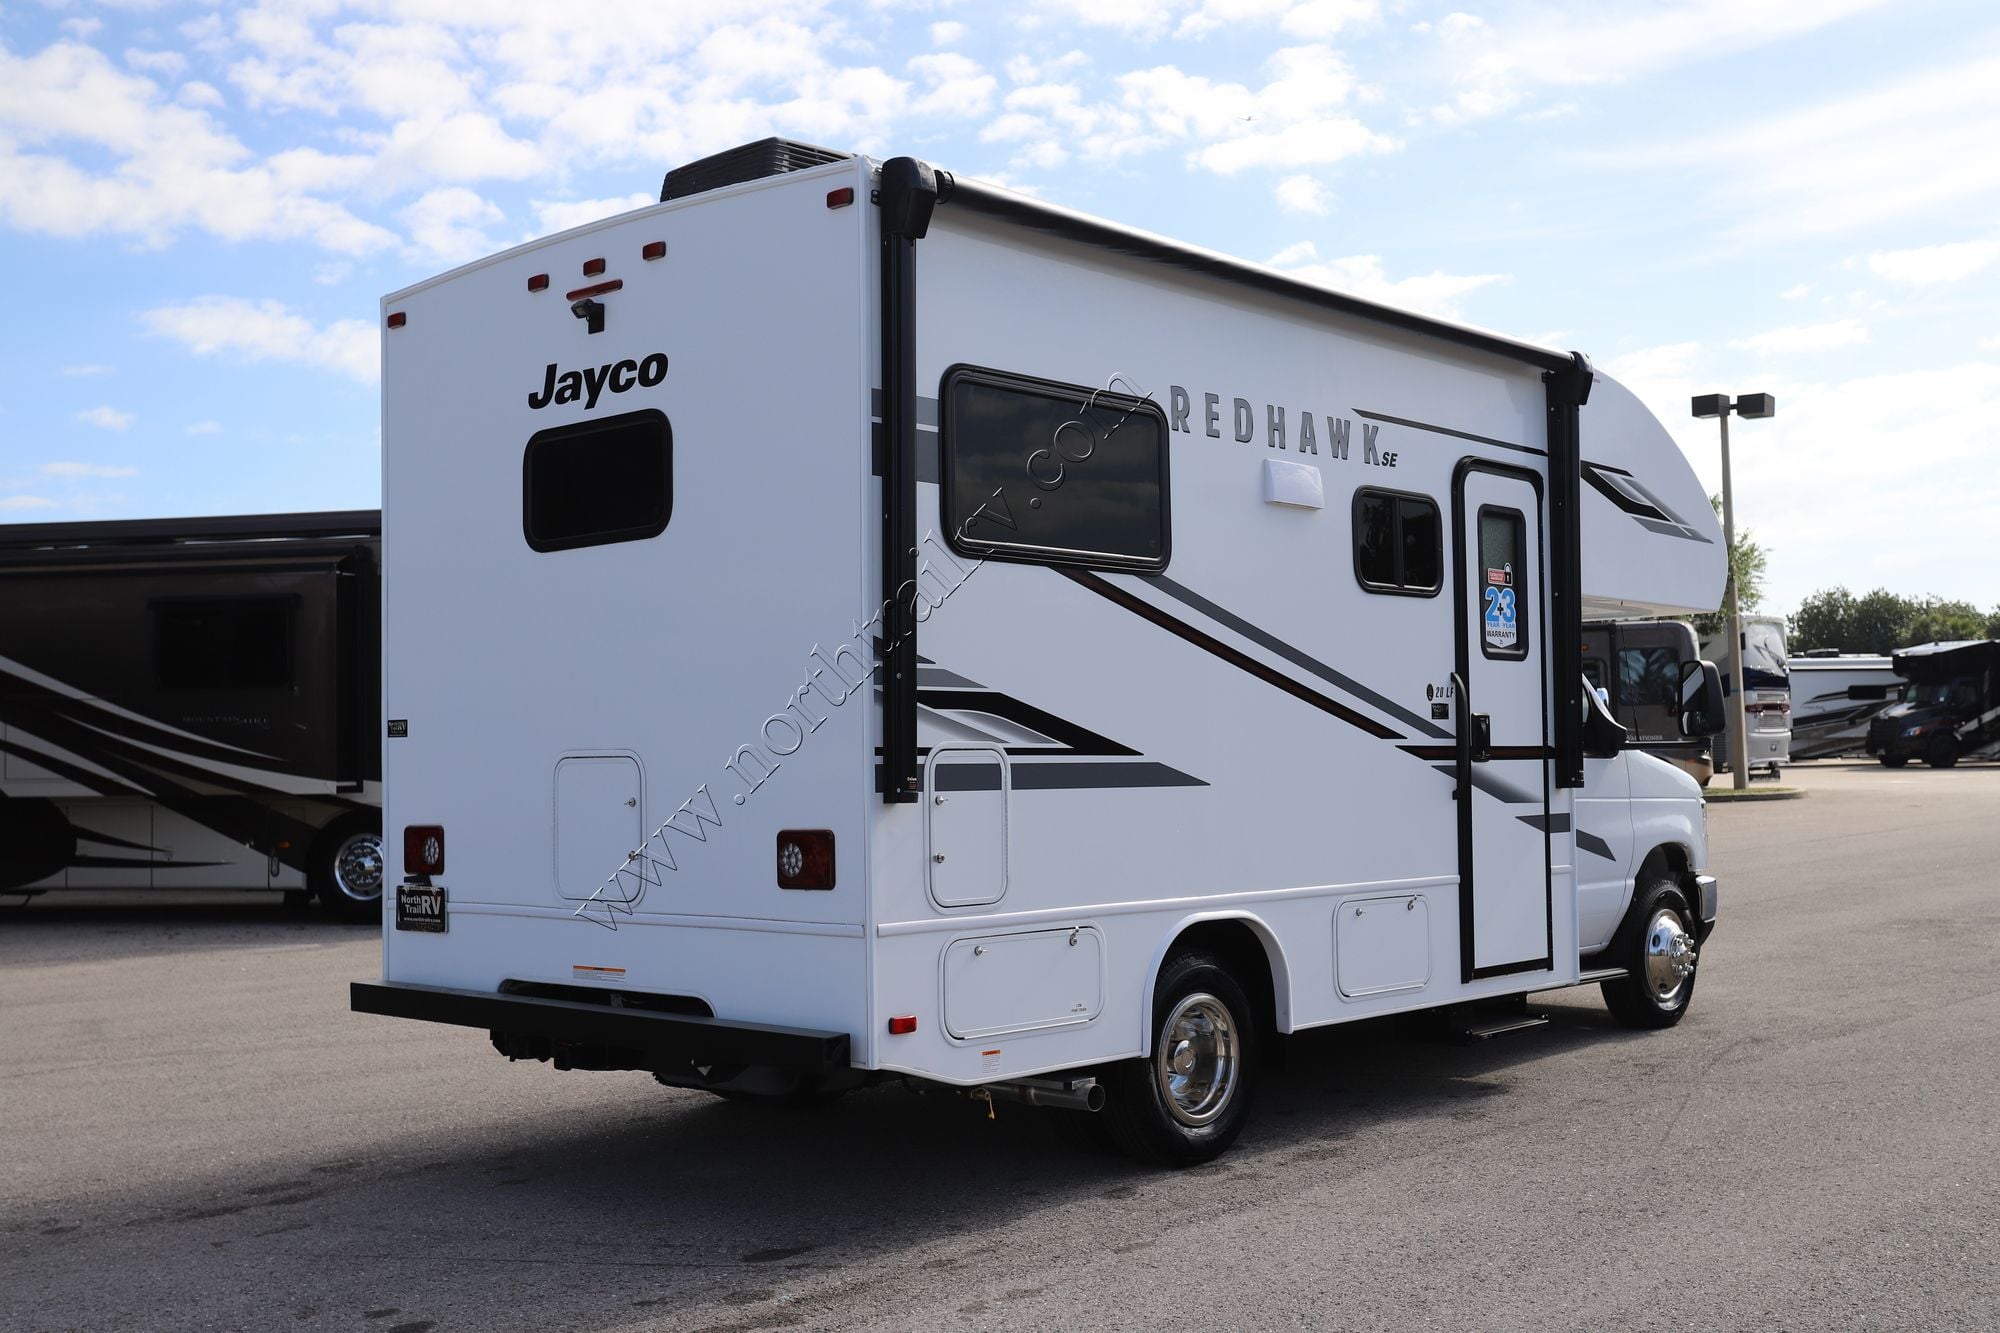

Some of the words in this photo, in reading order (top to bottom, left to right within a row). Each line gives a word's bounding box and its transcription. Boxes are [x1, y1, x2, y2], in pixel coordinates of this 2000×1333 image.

[528, 352, 668, 410] Jayco
[1170, 385, 1381, 465] REDHAWK
[1381, 451, 1398, 468] SE
[1486, 630, 1515, 639] WARRANTY
[1436, 687, 1444, 697] 20
[401, 894, 421, 904] North
[405, 904, 421, 914] Trail
[421, 895, 441, 915] RV
